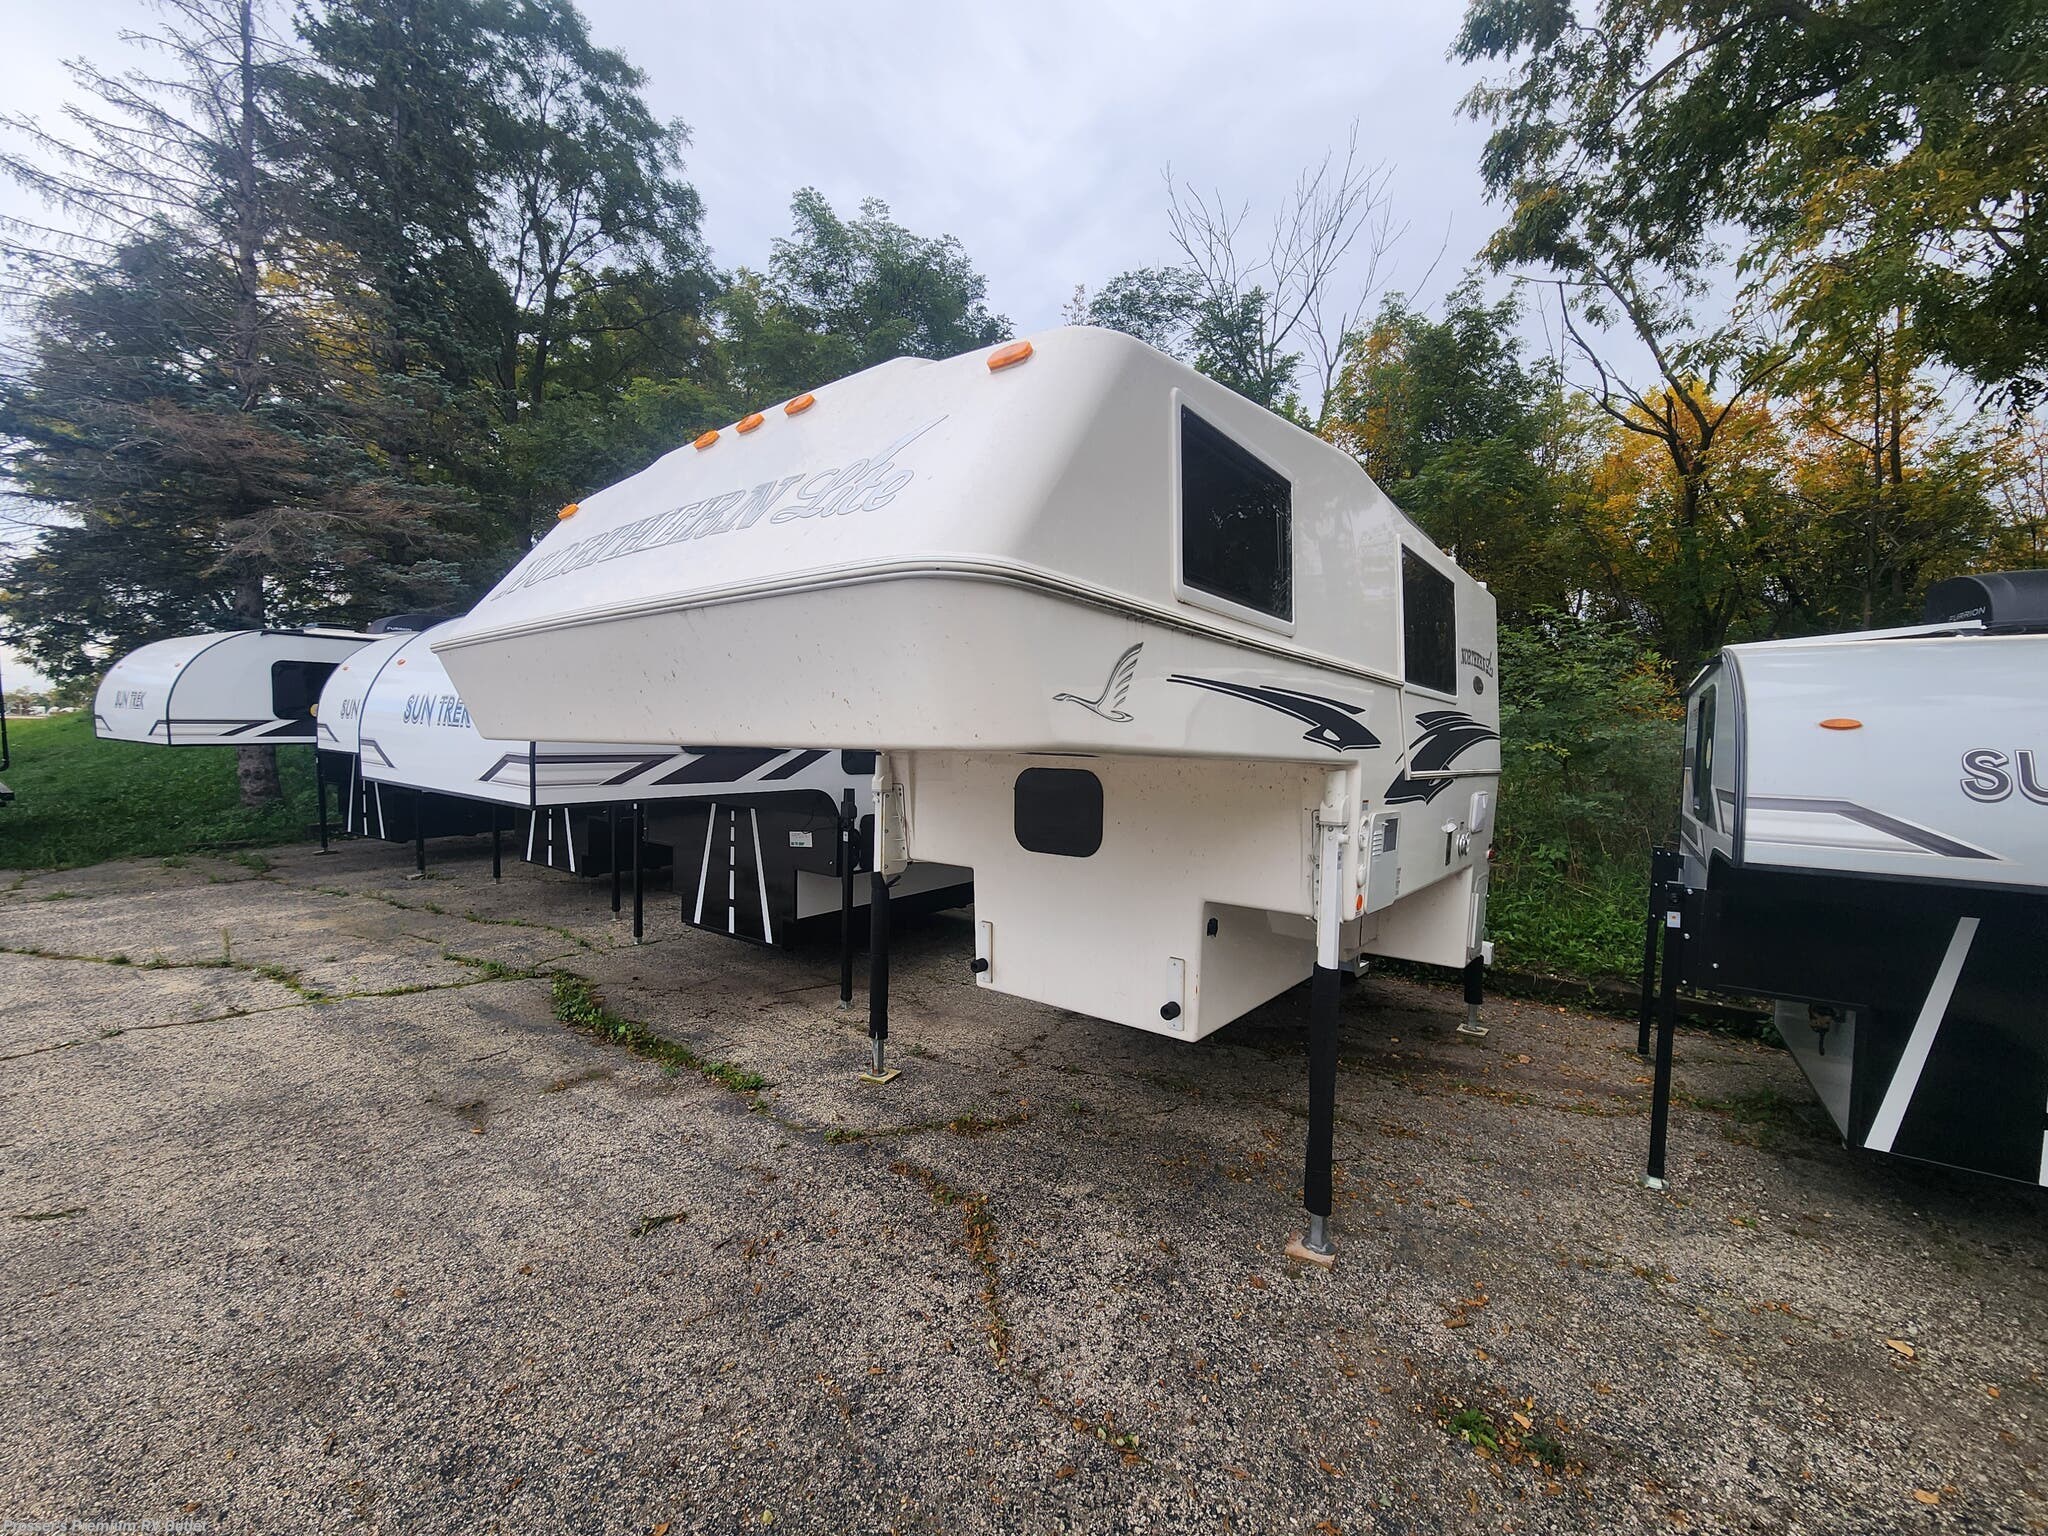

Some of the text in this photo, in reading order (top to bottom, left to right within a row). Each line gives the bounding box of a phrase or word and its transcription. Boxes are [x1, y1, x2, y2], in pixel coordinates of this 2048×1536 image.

[490, 414, 948, 601] NORTHERN Lite
[1948, 606, 1986, 622] FURRION
[129, 690, 147, 711] TREK
[340, 698, 361, 720] SUN
[403, 694, 437, 727] SUN
[1960, 747, 2048, 806] SU
